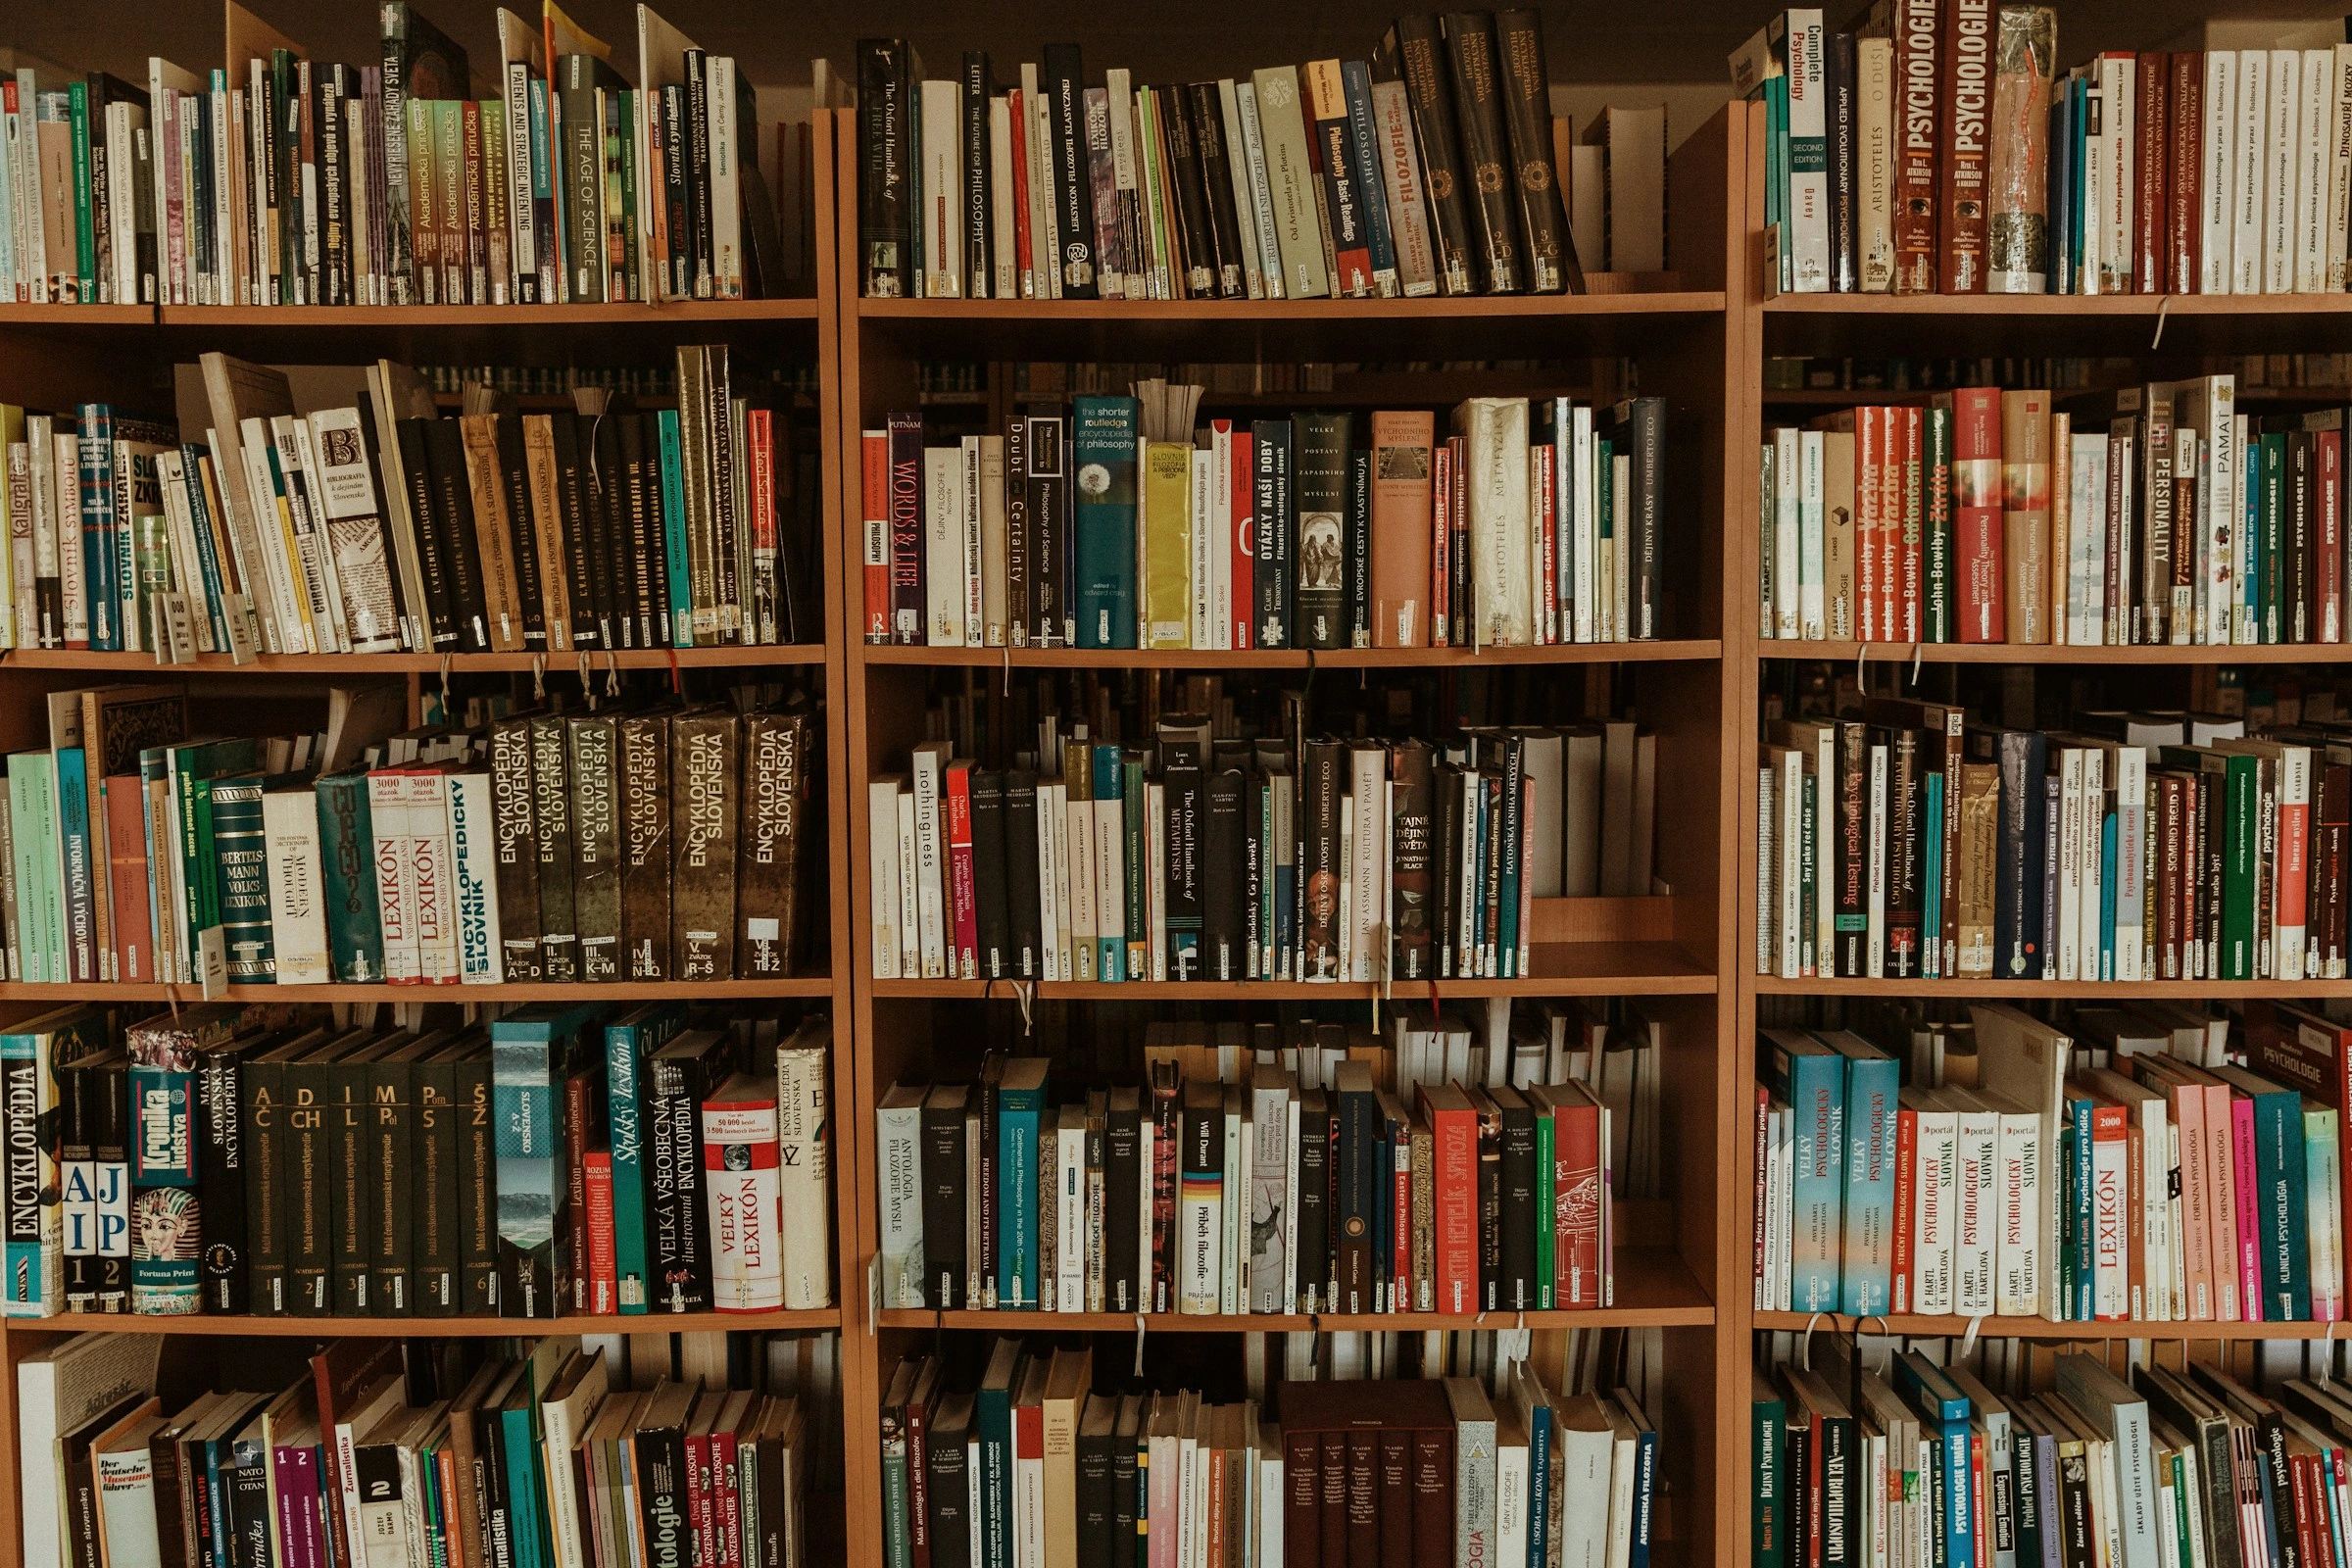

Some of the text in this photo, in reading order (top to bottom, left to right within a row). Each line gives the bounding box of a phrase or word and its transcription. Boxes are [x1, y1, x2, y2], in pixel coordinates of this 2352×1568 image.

[971, 65, 980, 95] LEITER
[1791, 32, 1805, 101] Psychology
[1807, 25, 1821, 82] Complete
[1909, 0, 1935, 148] PSYCHOLOGIE
[1955, 0, 1987, 150] PSYCHOLOGIE
[321, 83, 336, 122] vynálezů
[384, 57, 403, 186] NEVYRIEŠENÉ ZÁHADY SVETA
[1354, 99, 1374, 185] PHILOSOPHY
[1838, 87, 1848, 193] APPLIED EVOLUTIONARY
[1871, 47, 1884, 212] ARISTOTELÉS O DUŠI
[322, 133, 337, 163] objevů
[325, 166, 339, 220] evropských
[444, 110, 458, 228] Akademická príručka
[465, 111, 479, 229] Akademická príručka
[513, 72, 530, 231] PATENTS AND STRATEGIC INVENTING
[1062, 78, 1080, 232] LEKSYKON FILOZOFII KLASYCZNEJ
[1329, 127, 1355, 242] Philosophy Basic Readings
[1390, 123, 1415, 203] FILOZOFIE
[327, 221, 341, 249] Dějiny
[580, 127, 596, 267] THE AGE OF SCIENCE
[972, 169, 984, 244] PHILOSOPHY
[1804, 188, 1815, 218] Davey
[1009, 423, 1023, 581] Doubt Certainty
[1259, 439, 1272, 560] OTÁZKY NAŠÍ DOBY
[1356, 458, 1365, 466] JÁ
[1356, 469, 1365, 518] VLASTNÍMU
[895, 460, 917, 586] WORDS & LIFE
[1277, 477, 1286, 560] Filozoficko-teologický
[1644, 494, 1653, 525] KRÁSY
[1644, 528, 1653, 563] DĚJINY
[2156, 459, 2170, 562] PERSONALITY
[298, 536, 325, 613] CHRONOLÓGIA
[1354, 558, 1364, 601] EVROPSKÉ
[493, 731, 515, 862] ENCYKLOPÉDIA
[512, 730, 531, 835] SLOVENSKA
[534, 731, 553, 862] ENCYKLOPÉDIA
[550, 729, 564, 832] SLOVENSKA
[580, 730, 596, 862] ENCYKLOPÉDIA
[596, 730, 609, 832] SLOVENSKA
[627, 733, 644, 864] ENCYKLOPÉDIA
[643, 733, 657, 835] SLOVENSKA
[687, 734, 706, 866] ENCYKLOPÉDIA
[708, 734, 722, 839] SLOVENSKA
[757, 730, 776, 862] ENCYKLOPÉDIA
[776, 730, 792, 835] SLOVENSKA
[919, 770, 933, 866] nothingness
[1321, 782, 1330, 828] UMBERTO
[1362, 772, 1372, 803] PAMĚŤ
[2262, 792, 2273, 853] psychologie
[452, 780, 475, 972] ENCYKLOPEDICKÝ
[1320, 837, 1329, 892] OŠKLIVOSTI
[1362, 816, 1371, 860] KULTURA
[1844, 772, 1862, 905] Psychological Testing
[2168, 795, 2180, 871] SIGMUND FREUD
[378, 839, 402, 941] LEXIKÓN
[400, 839, 414, 939] VŠEOBECNÉHO VZDELANIA
[414, 839, 438, 941] LEXIKÓN
[472, 880, 489, 972] SLOVNÍK
[1319, 894, 1329, 927] DĚJINY
[1362, 919, 1371, 935] JAN
[142, 1090, 170, 1169] Kronika
[199, 1068, 209, 1105] MALÁ
[210, 1068, 222, 1145] SLOVENSKÁ
[224, 1067, 238, 1168] ENCYKLOPÉDIA
[612, 1042, 638, 1164] Školský lexikón
[7, 1066, 39, 1235] ENCYKLOPÉDIA
[171, 1113, 187, 1168] ľudstva
[1798, 1134, 1811, 1178] VELKÝ
[1816, 1088, 1829, 1178] PSYCHOLOGICKÝ
[1831, 1105, 1841, 1165] SLOVNÍK
[1852, 1138, 1864, 1182] VELKÝ
[1869, 1092, 1883, 1182] PSYCHOLOGICKÝ
[1885, 1109, 1896, 1169] SLOVNÍK
[1939, 1141, 1952, 1187] SLOVNÍK
[1980, 1142, 1992, 1189] SLOVNÍK
[2022, 1141, 2034, 1188] SLOVNÍK
[346, 1132, 356, 1252] Malá československá encyklopedie
[650, 1097, 676, 1263] VEĽKÁ VŠEOBECNÁ
[675, 1098, 694, 1263] ilustrovaná ENCYKLOPÉDIA
[716, 1192, 735, 1253] VEĽKÝ
[739, 1178, 760, 1268] LEXIKÓN
[1924, 1157, 1938, 1244] PSYCHOLOGICKÝ
[1964, 1158, 1978, 1246] PSYCHOLOGICKÝ
[2005, 1158, 2020, 1245] PSYCHOLOGICKÝ
[2096, 1169, 2117, 1268] LEXIKÓN
[2277, 1180, 2289, 1283] KLINICKÁ PSYCHOLÓGIA
[341, 1437, 354, 1493] Žurnalistika
[686, 1445, 698, 1488] FILOSOFIE
[691, 1490, 698, 1498] do
[1640, 1445, 1651, 1545] AMERICKÁ FILOZOFIA
[1760, 1419, 1772, 1497] DĚJINY PSYCHOLOGIE
[1950, 1435, 1966, 1533] PSYCHOLOGIE UMĚNÍ
[2019, 1437, 2034, 1528] Přehled PSYCHOLOGIE
[2270, 1428, 2288, 1487] psychologie
[702, 1499, 712, 1564] ANZENBACHER
[1829, 1454, 1844, 1562] NEUROPHILOSOPHY
